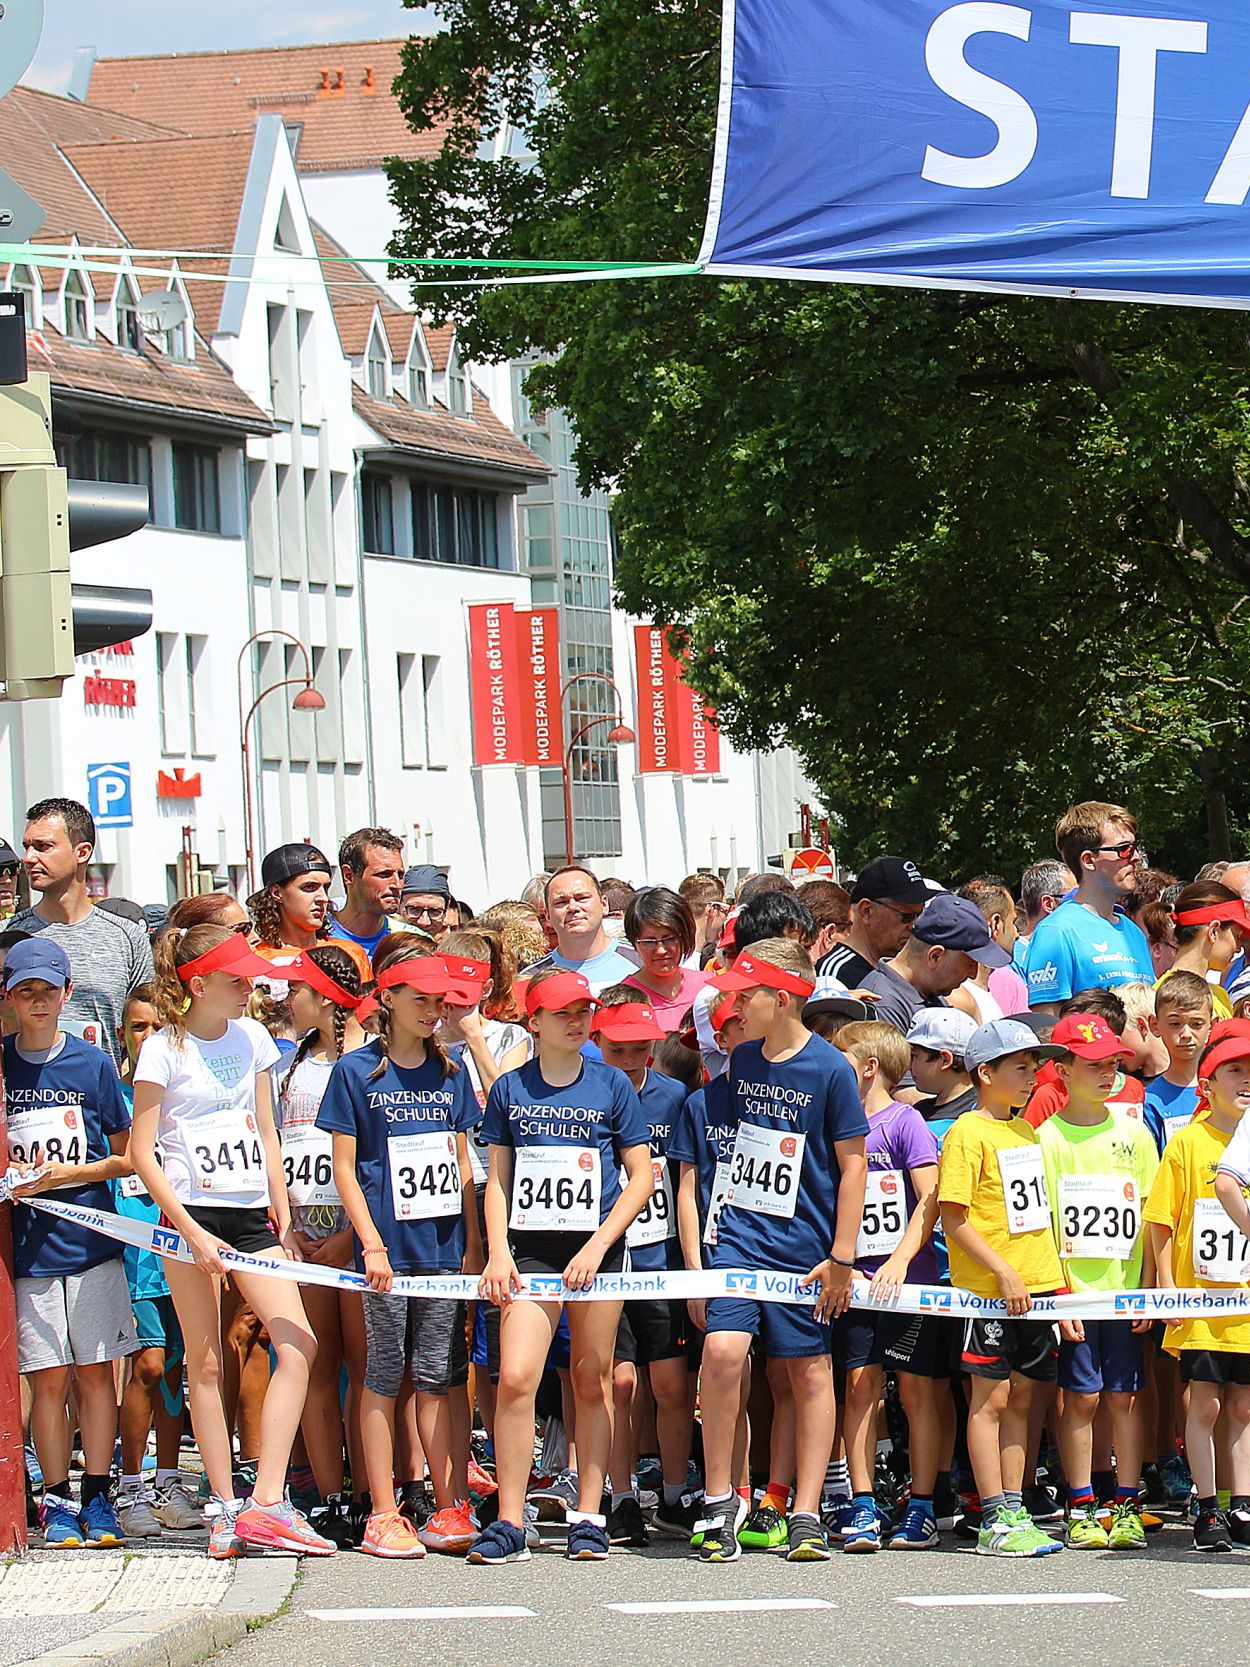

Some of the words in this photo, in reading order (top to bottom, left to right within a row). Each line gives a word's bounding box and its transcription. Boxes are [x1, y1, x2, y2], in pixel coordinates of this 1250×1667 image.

[486, 607, 504, 671] RÖTHER
[530, 615, 546, 675] RÖTHER
[649, 629, 664, 687] RÖTHER
[489, 674, 507, 761] MODEPARK
[533, 679, 551, 761] MODEPARK
[652, 690, 667, 768] MODEPARK
[691, 692, 707, 771] MODEPARK
[98, 777, 126, 814] P
[5, 1089, 86, 1105] NZENDORF
[737, 1079, 813, 1108] ZINZENDORF
[745, 1098, 799, 1122] SCHULEN
[385, 1106, 449, 1123] SCHULEN
[508, 1104, 605, 1124] ZINZENDORF
[519, 1120, 591, 1140] SCHULEN
[195, 1139, 263, 1174] 3414
[283, 1154, 332, 1188] 346
[398, 1161, 460, 1199] 3428
[731, 1152, 793, 1196] 3446
[518, 1177, 594, 1210] 3464
[862, 1201, 901, 1236] 55
[1064, 1205, 1137, 1240] 3230
[392, 1279, 472, 1294] olksbank
[763, 1274, 861, 1300] Volksbk
[958, 1291, 1056, 1311] Volksnk
[1151, 1292, 1249, 1310] Volksbank
[885, 1348, 911, 1362] uhlsport
